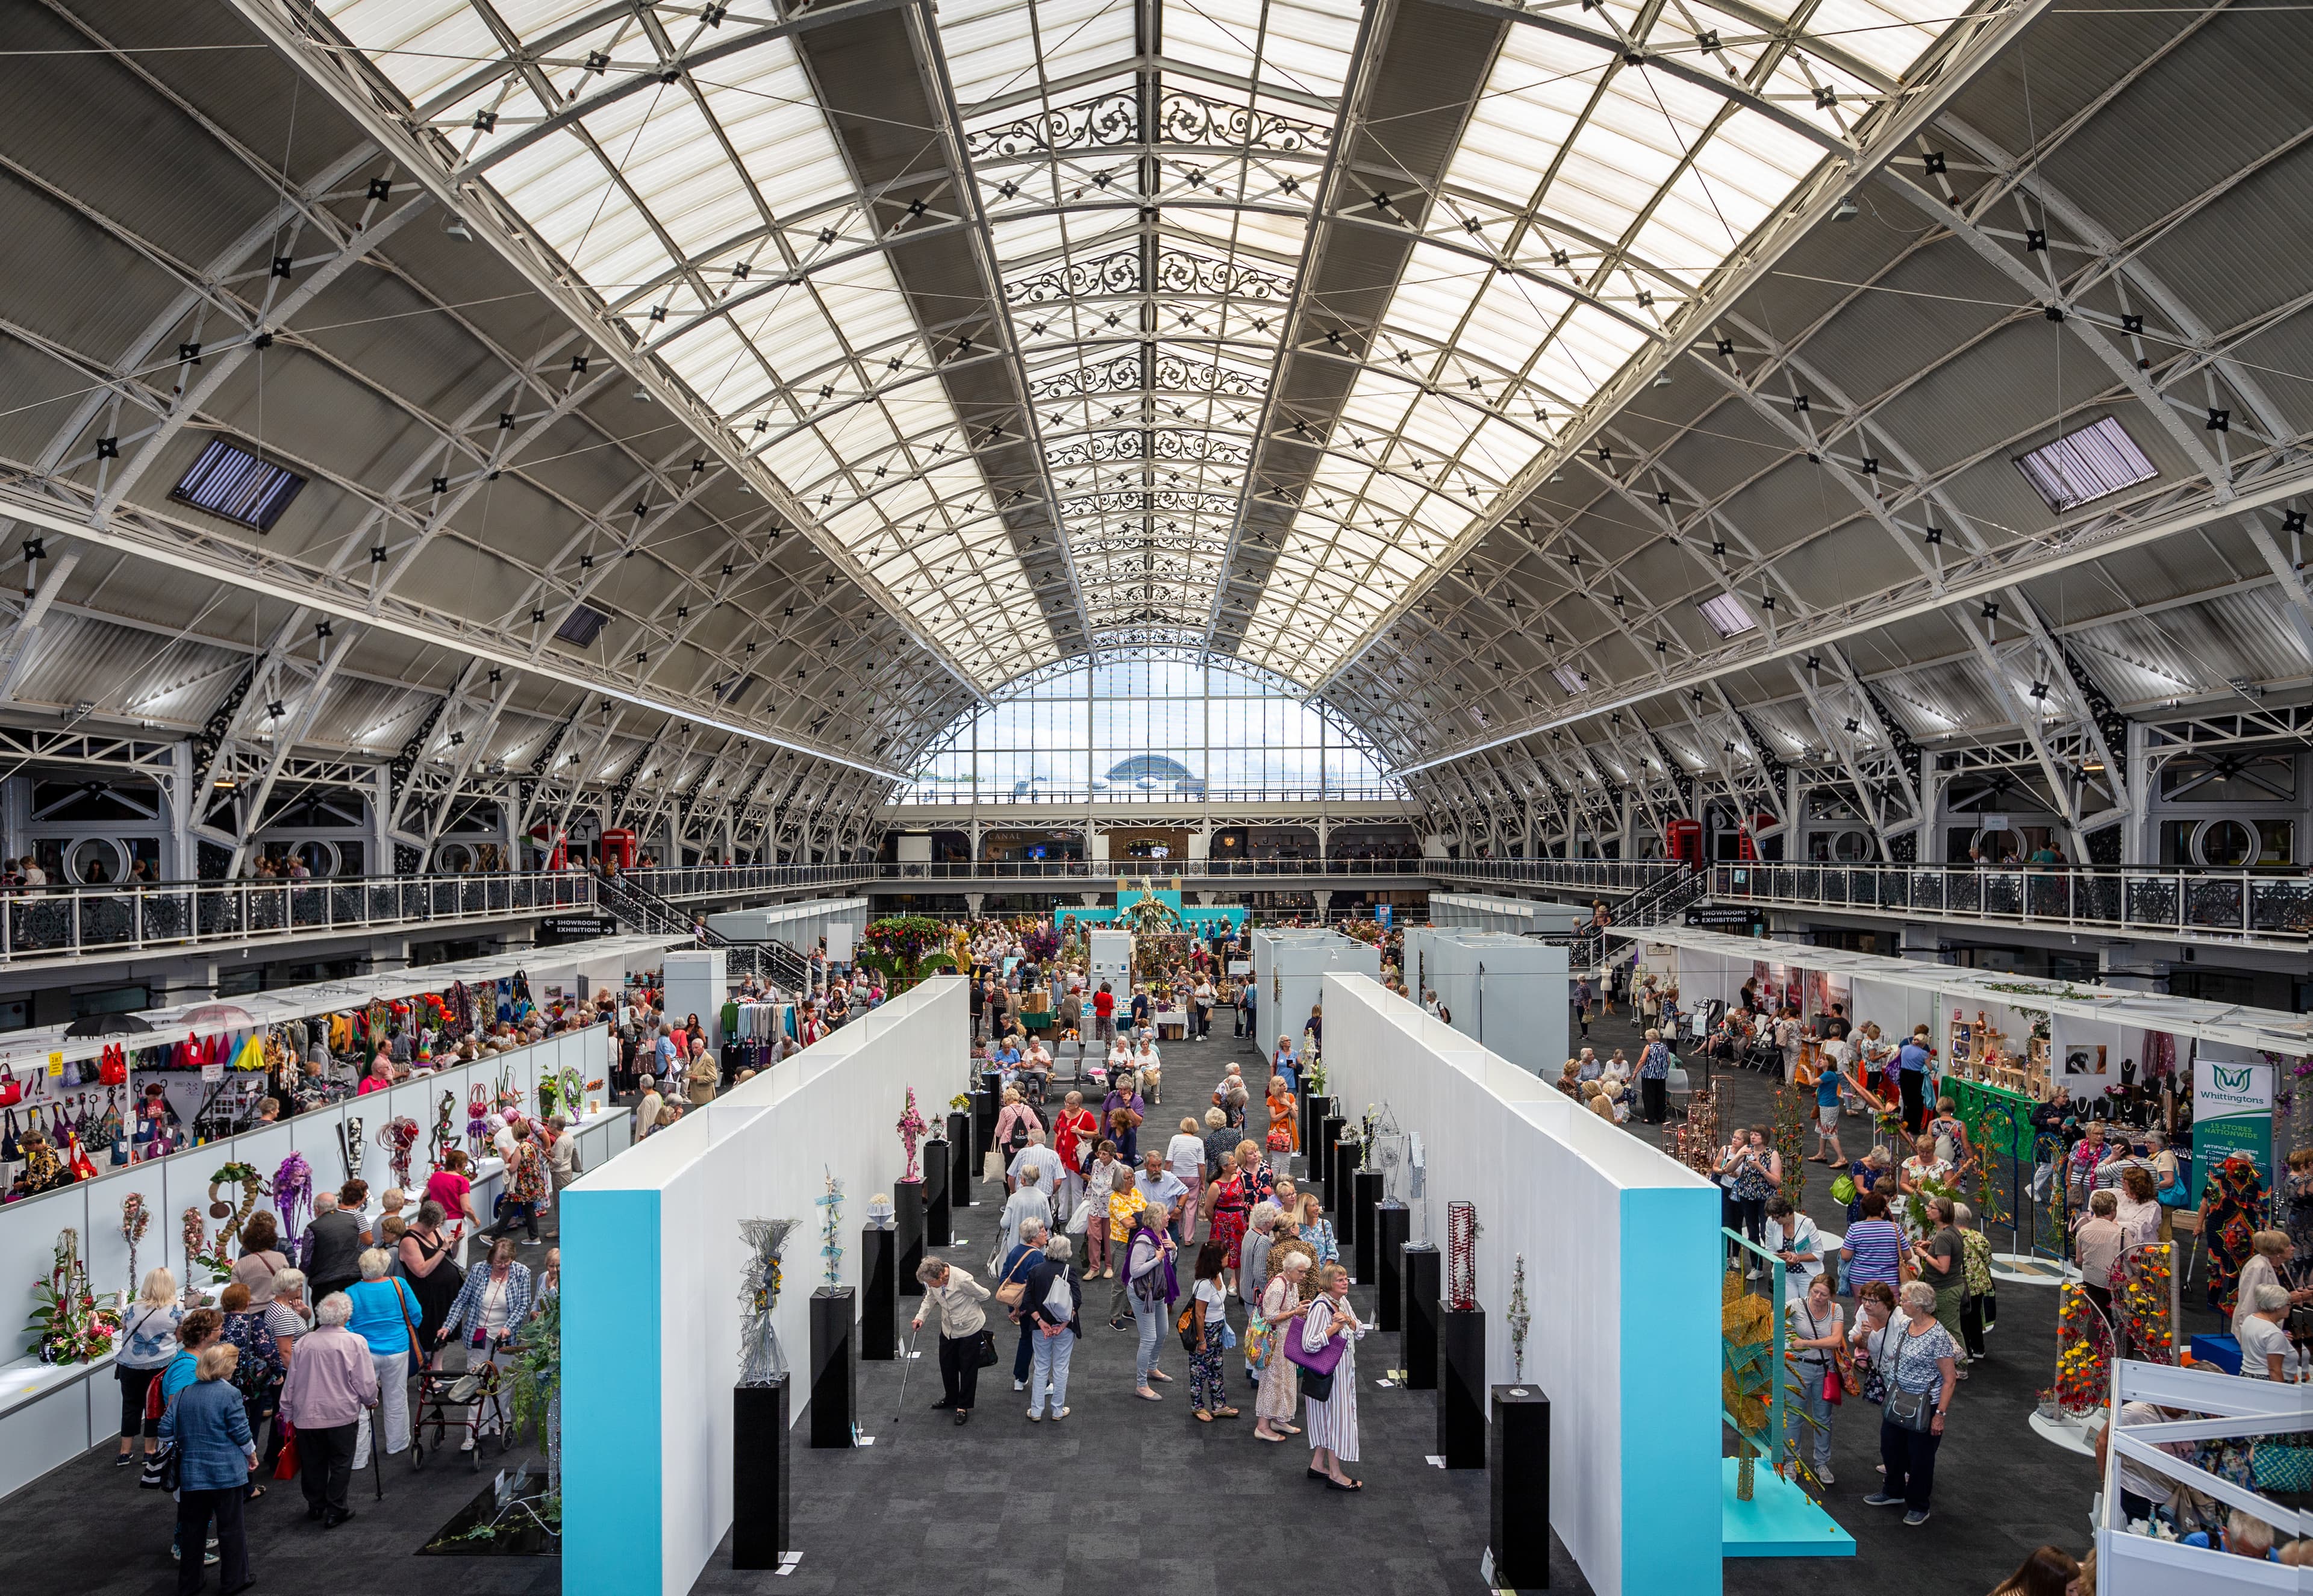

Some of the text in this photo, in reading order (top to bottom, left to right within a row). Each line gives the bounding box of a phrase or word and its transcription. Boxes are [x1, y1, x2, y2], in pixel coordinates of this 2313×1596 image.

[2200, 1091, 2264, 1104] Whittingtons
[2205, 1128, 2258, 1139] NATIONWIDE
[2221, 1124, 2252, 1133] STORES
